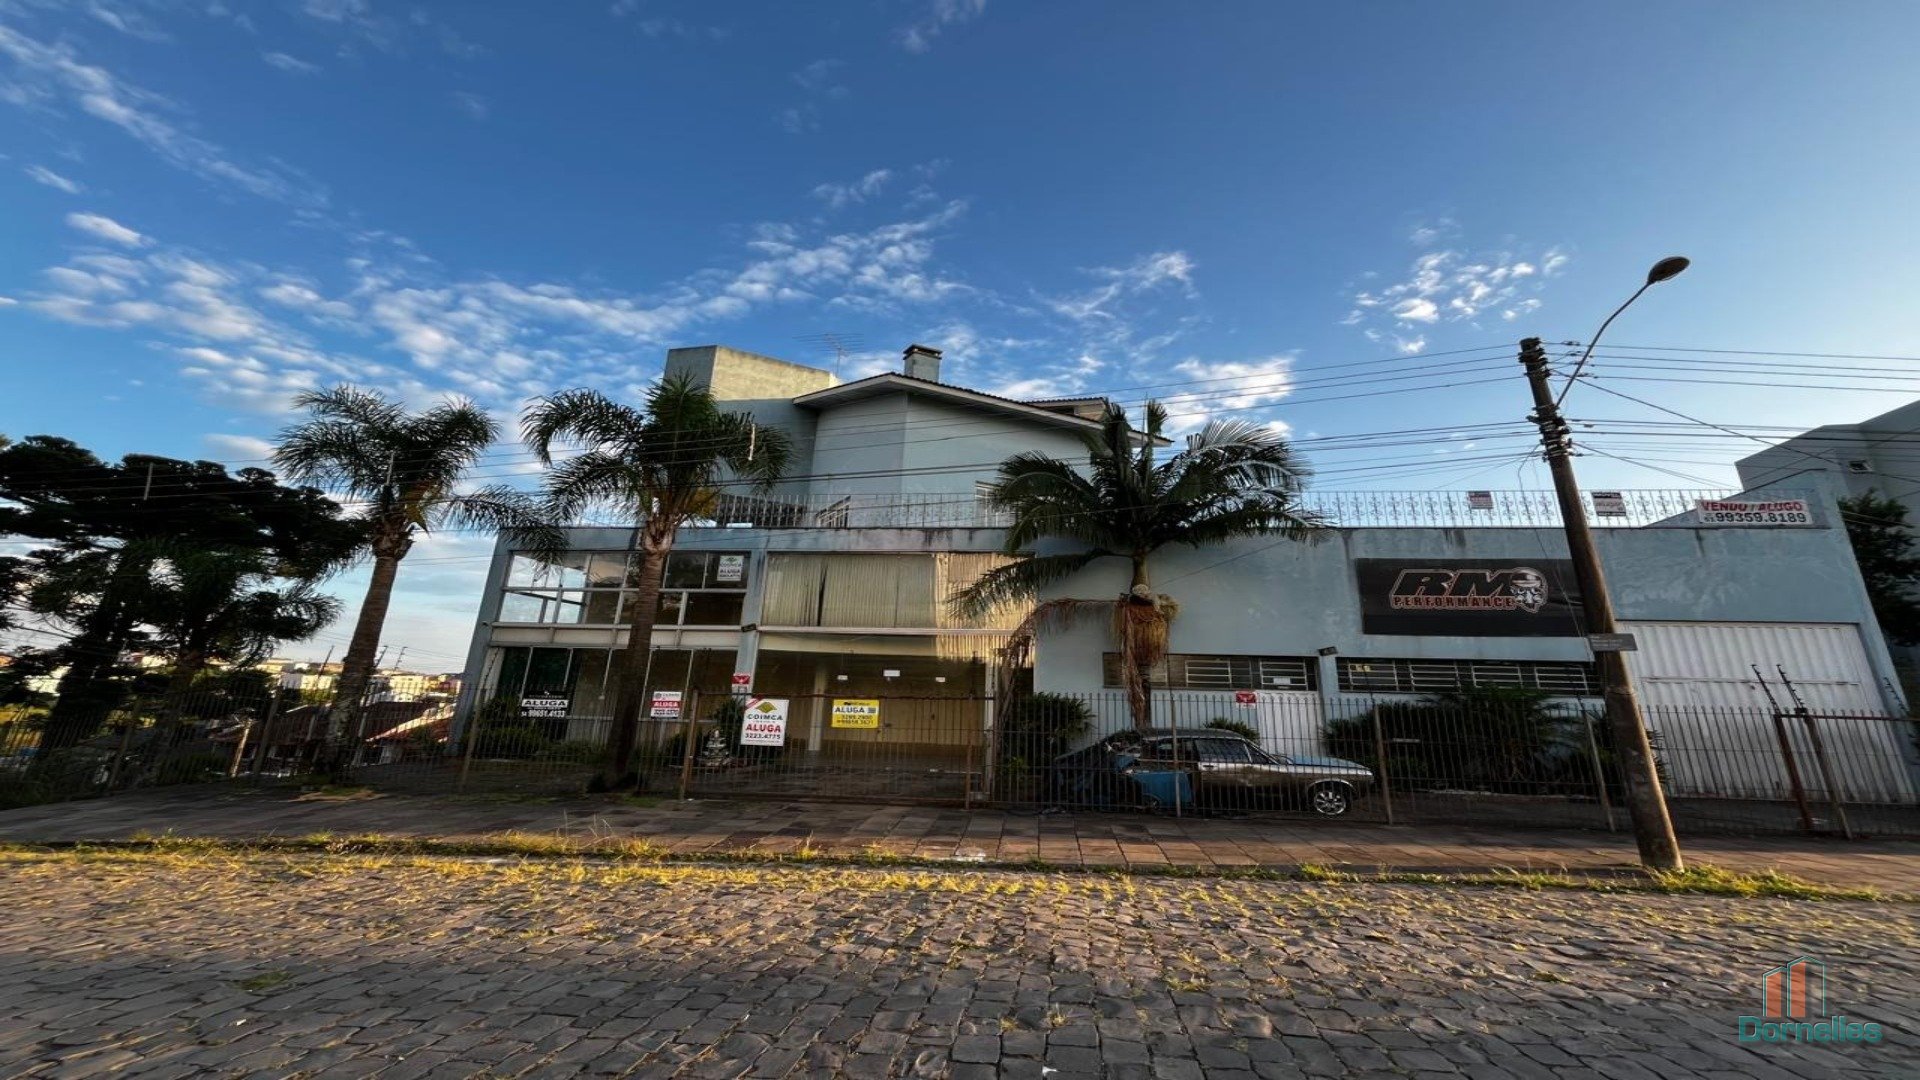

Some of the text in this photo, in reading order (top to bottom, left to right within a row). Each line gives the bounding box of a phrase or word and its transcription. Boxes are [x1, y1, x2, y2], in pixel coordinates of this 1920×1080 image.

[1701, 501, 1747, 512] VENDO
[1758, 501, 1803, 512] ALUGO
[1393, 596, 1515, 608] PERFORMANCE
[747, 713, 784, 721] COIMCA
[745, 723, 782, 733] ALUGA
